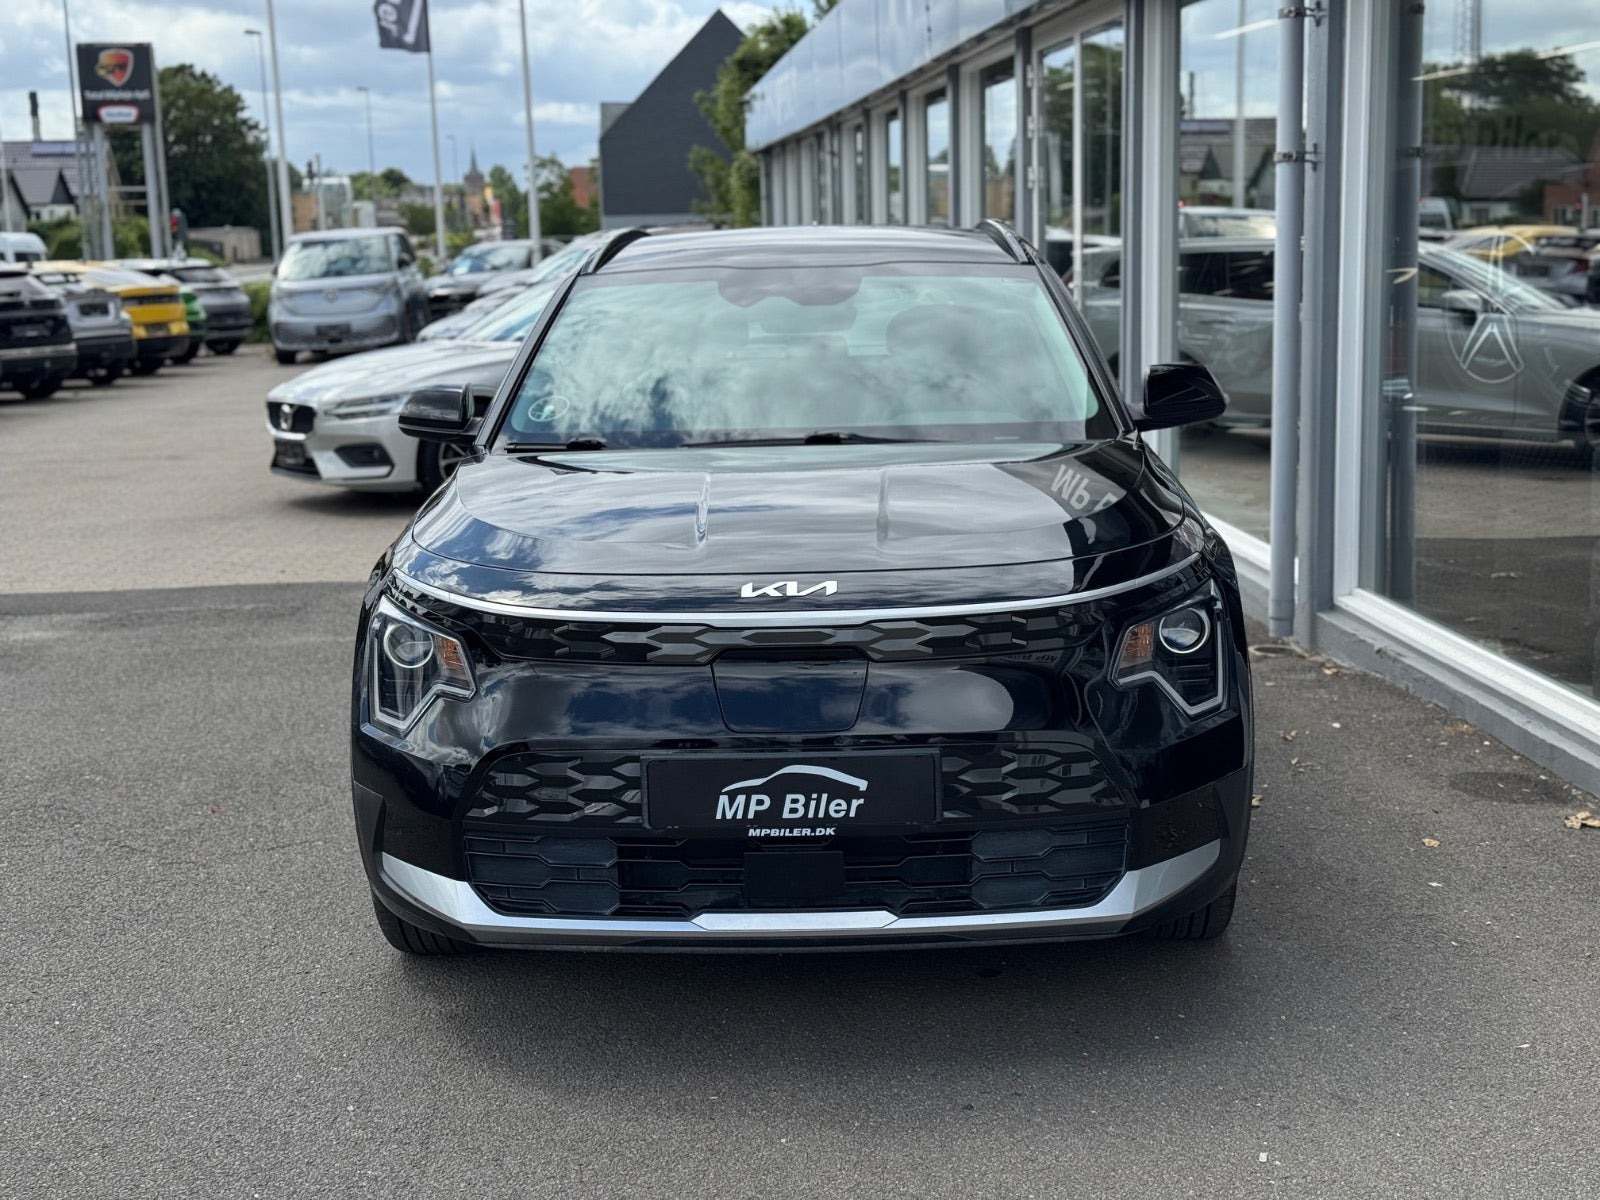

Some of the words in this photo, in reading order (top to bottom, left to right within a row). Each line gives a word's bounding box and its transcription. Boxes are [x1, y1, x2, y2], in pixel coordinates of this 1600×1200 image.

[741, 581, 838, 598] KIA
[715, 794, 771, 820] MP
[782, 793, 865, 819] Biler
[748, 827, 836, 837] MPBILER.DK
